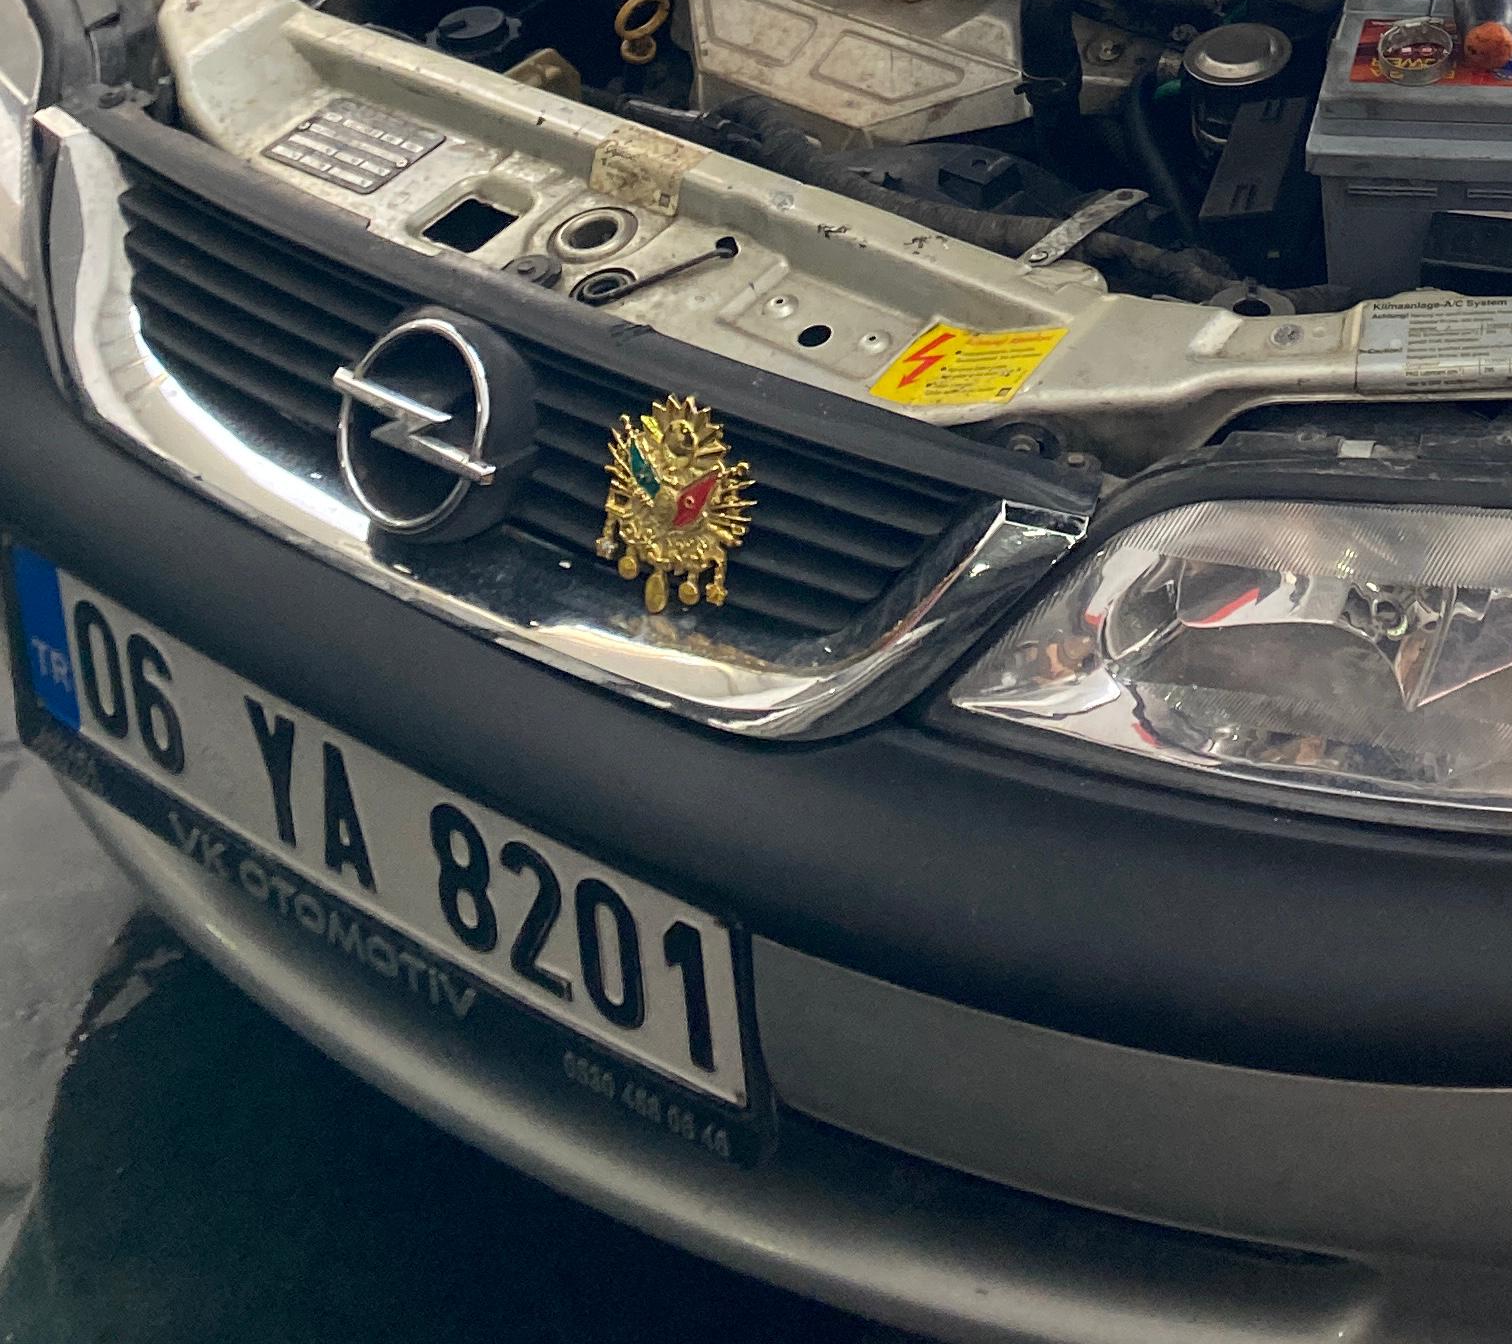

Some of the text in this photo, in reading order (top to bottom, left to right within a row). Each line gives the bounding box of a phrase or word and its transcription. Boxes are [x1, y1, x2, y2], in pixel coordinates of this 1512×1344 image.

[1466, 298, 1508, 308] System
[31, 634, 71, 689] TR
[73, 598, 716, 1074] 06 YA 8201
